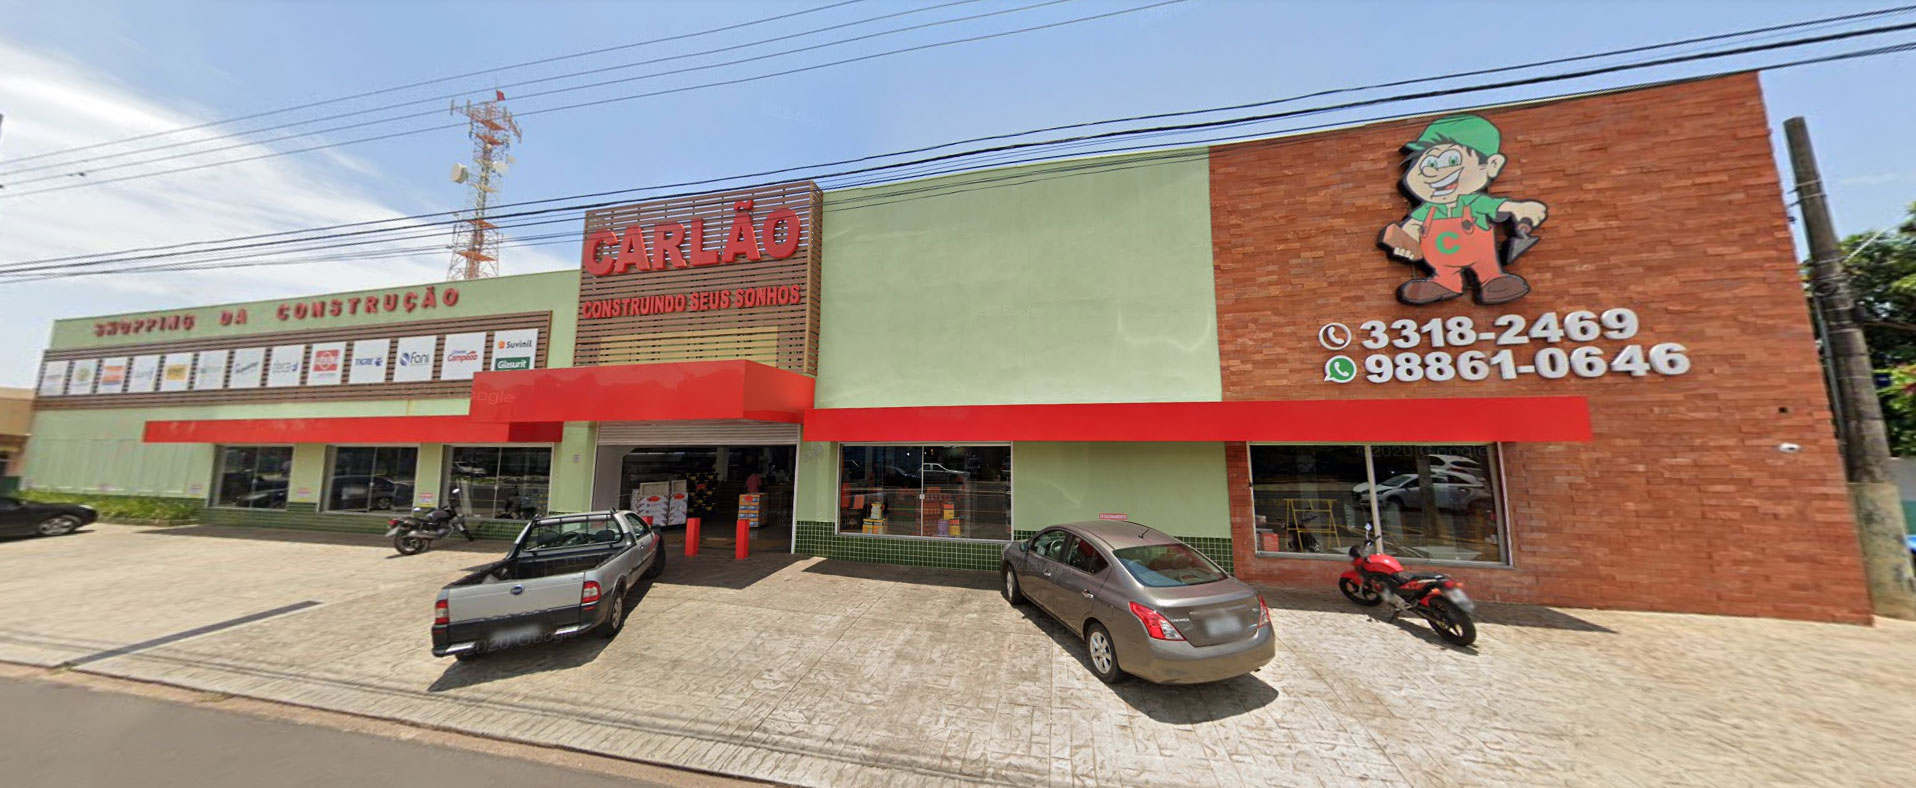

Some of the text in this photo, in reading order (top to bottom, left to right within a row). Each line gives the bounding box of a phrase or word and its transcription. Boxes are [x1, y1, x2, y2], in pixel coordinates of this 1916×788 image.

[583, 199, 802, 276] CARLÃO
[1435, 231, 1460, 255] C
[94, 286, 460, 338] SHOPPING DA CONSTRUÇÃO
[582, 284, 801, 319] CONSTRUINDO SEUS SONHOS
[506, 340, 532, 349] Suvinil
[1360, 307, 1640, 350] 3318-2469
[497, 360, 527, 369] Glasurit
[1364, 342, 1691, 384] 98861-0646
